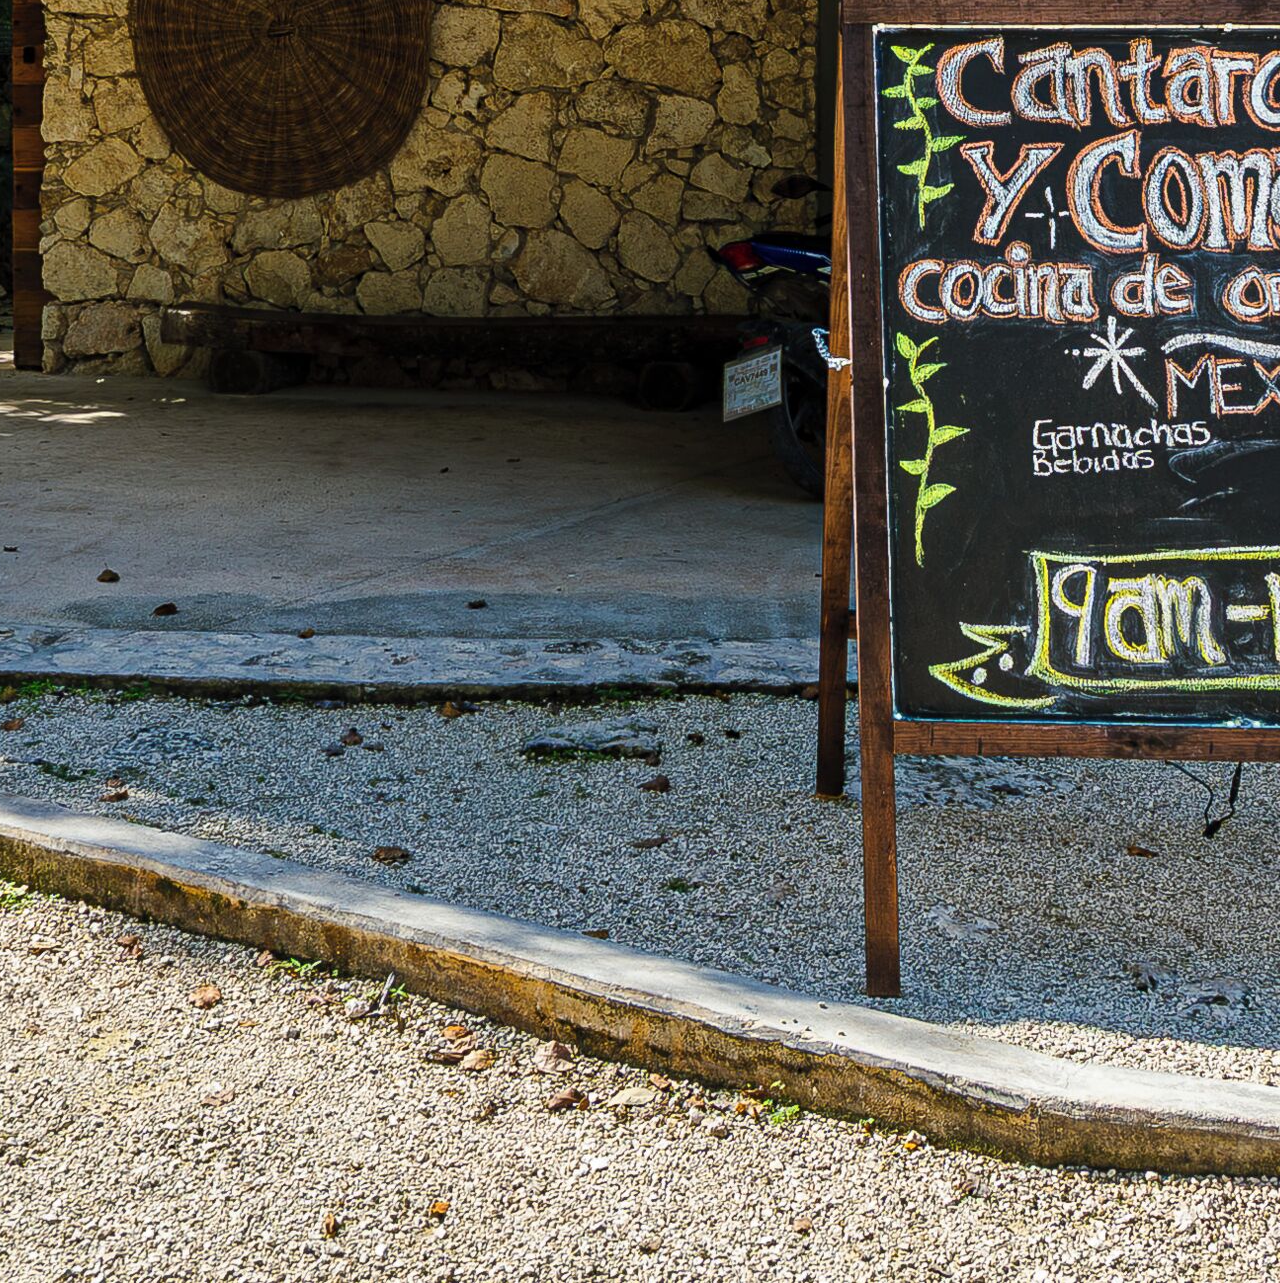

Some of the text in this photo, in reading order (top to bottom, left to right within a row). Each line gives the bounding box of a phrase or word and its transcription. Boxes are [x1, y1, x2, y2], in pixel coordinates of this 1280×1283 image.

[898, 241, 1099, 324] cocina
[1110, 253, 1195, 317] de
[1032, 418, 1211, 457] Garnachas
[1032, 449, 1155, 477] Bebidas
